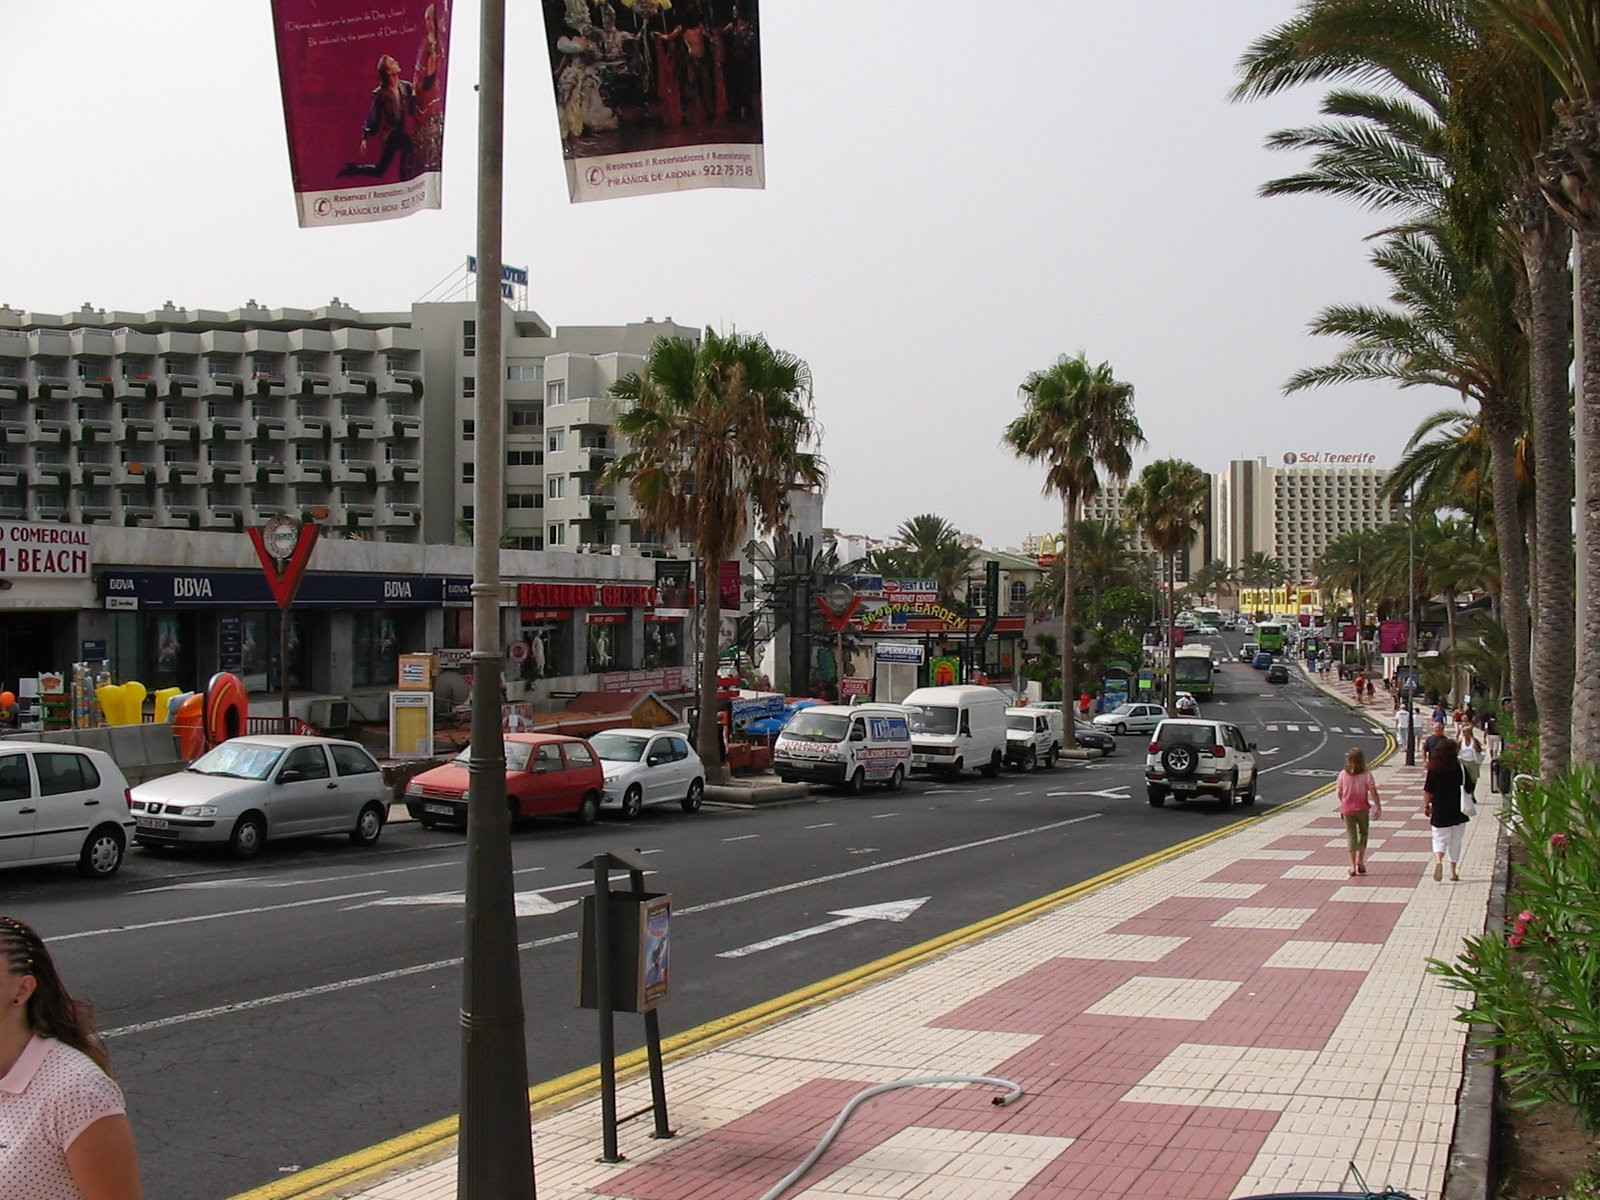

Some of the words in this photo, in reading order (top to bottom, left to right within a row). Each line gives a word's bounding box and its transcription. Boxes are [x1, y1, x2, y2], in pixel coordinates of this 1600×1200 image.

[606, 159, 643, 172] Reservas
[652, 152, 704, 167] Reservations
[651, 172, 663, 182] DE
[665, 168, 697, 181] ARONA
[703, 164, 722, 177] 922
[1299, 452, 1319, 463] Sol
[1323, 452, 1376, 464] Tenerife
[10, 526, 90, 546] COMERCIAL
[109, 578, 135, 590] BBVA
[173, 577, 213, 597] BBVA
[384, 580, 412, 598] BBVA
[449, 584, 469, 594] BBVA
[915, 602, 966, 630] GARDEN
[876, 645, 923, 656] SUPERMARKET
